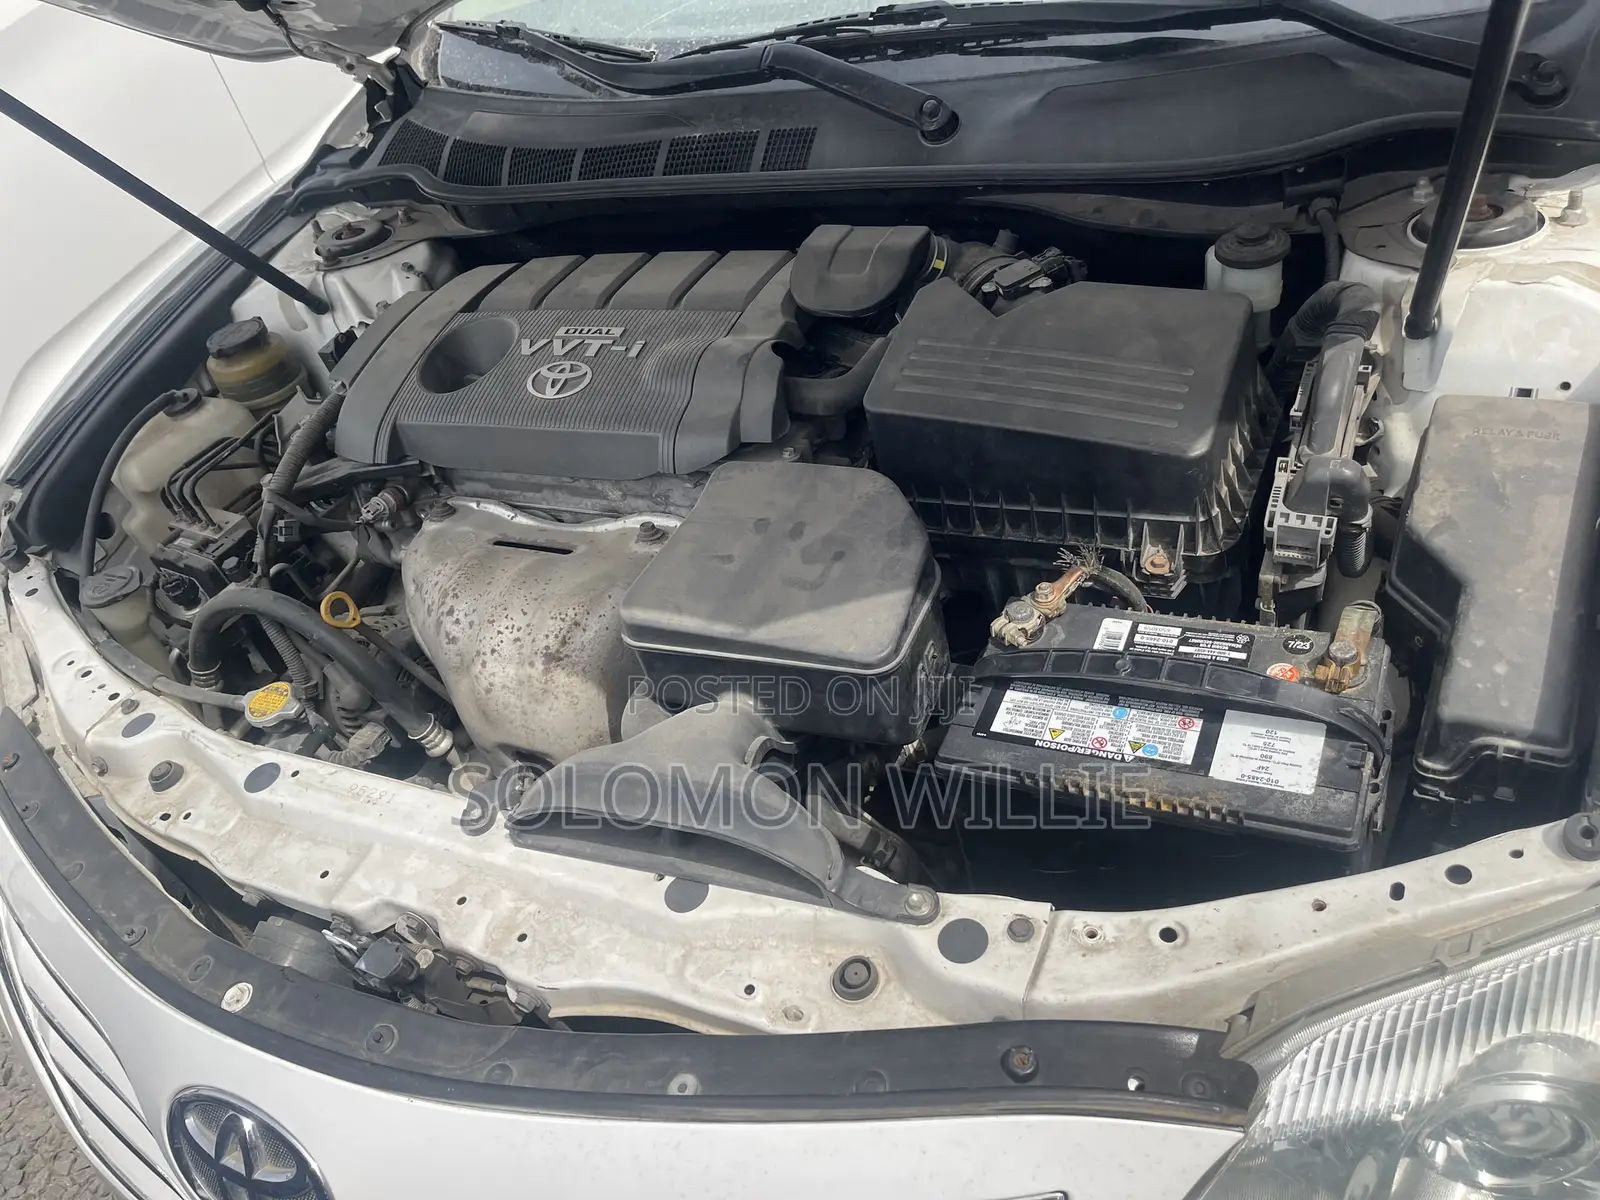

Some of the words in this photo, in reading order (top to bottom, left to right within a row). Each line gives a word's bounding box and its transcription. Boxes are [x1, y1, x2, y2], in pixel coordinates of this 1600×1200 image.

[563, 328, 616, 336] DUAL
[521, 338, 647, 359] VVT-i
[1472, 427, 1514, 437] RELAY
[1288, 640, 1310, 650] 7/23
[1034, 739, 1122, 761] DANGER/POISON
[1240, 773, 1280, 785] 010-2485-0
